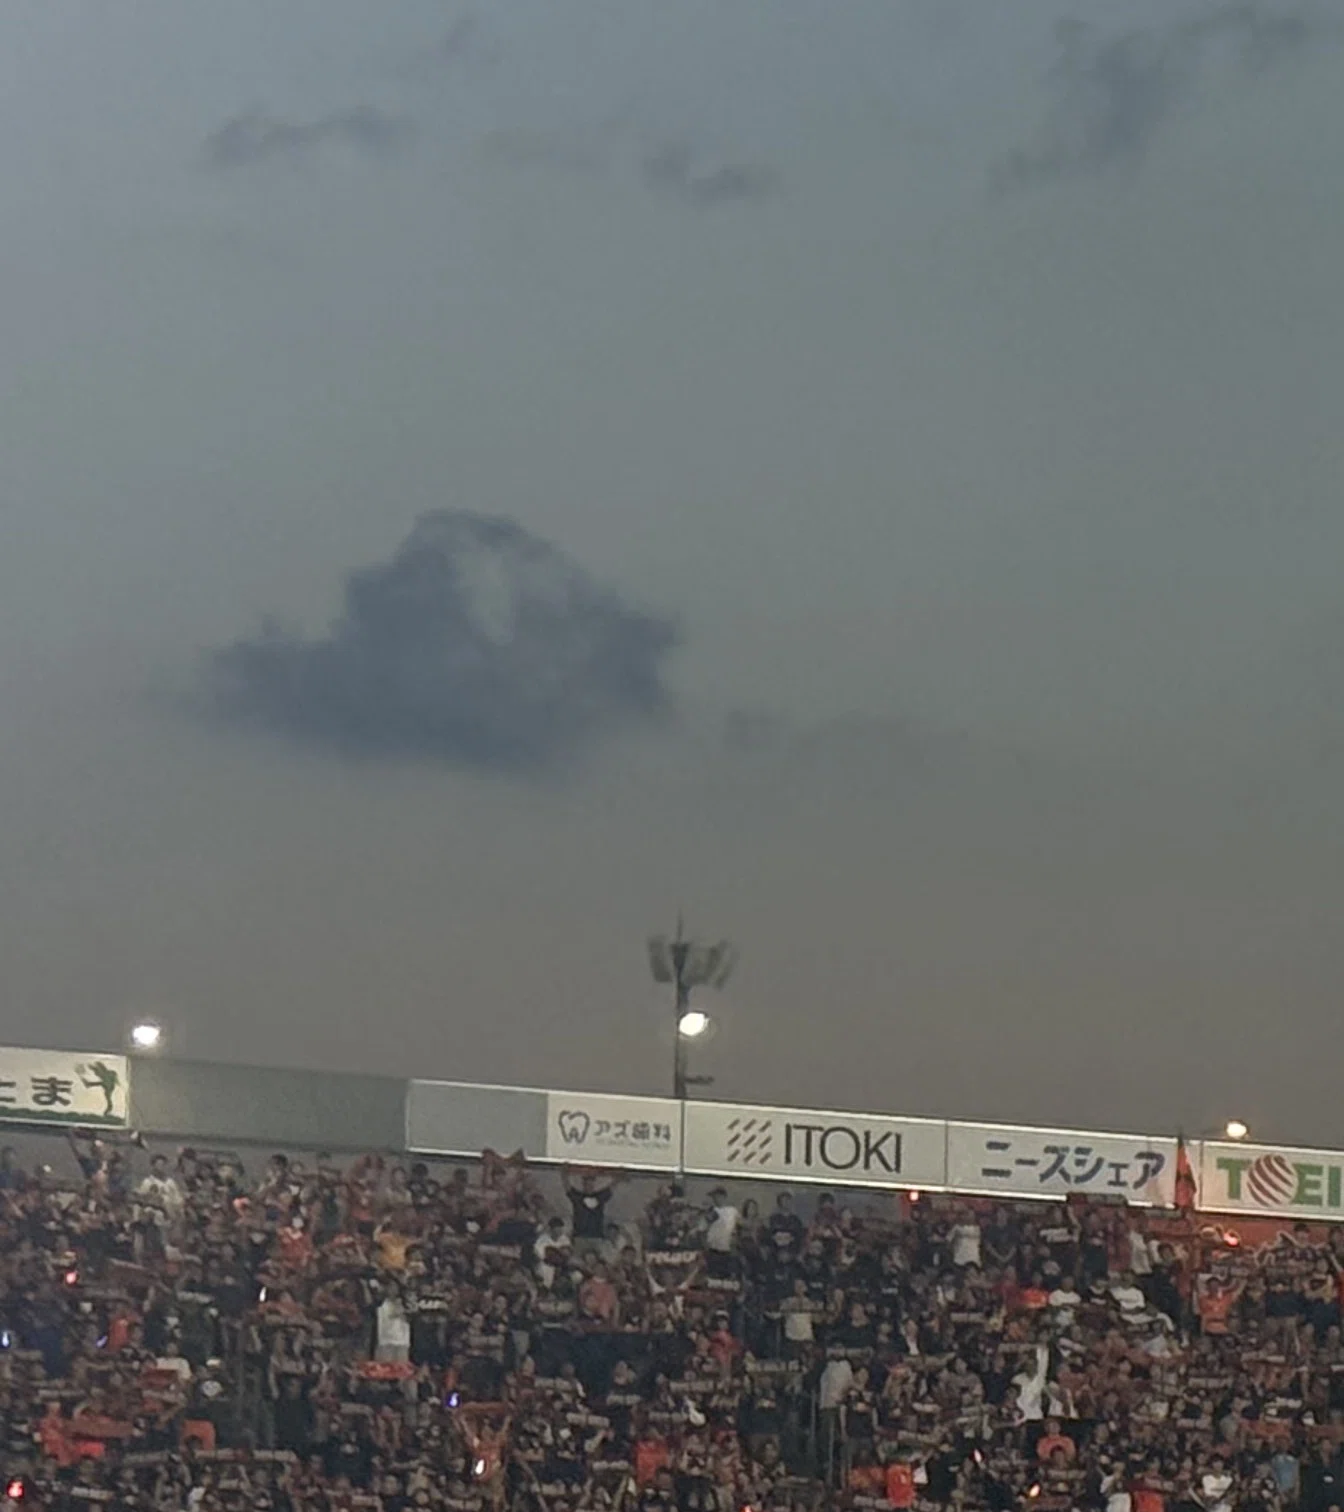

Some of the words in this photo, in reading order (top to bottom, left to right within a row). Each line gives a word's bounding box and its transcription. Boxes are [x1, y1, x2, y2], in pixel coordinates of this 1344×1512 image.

[784, 1123, 902, 1173] ITOKI
[981, 1140, 1166, 1190] ニーズシェア
[1216, 1154, 1342, 1208] TOEI
